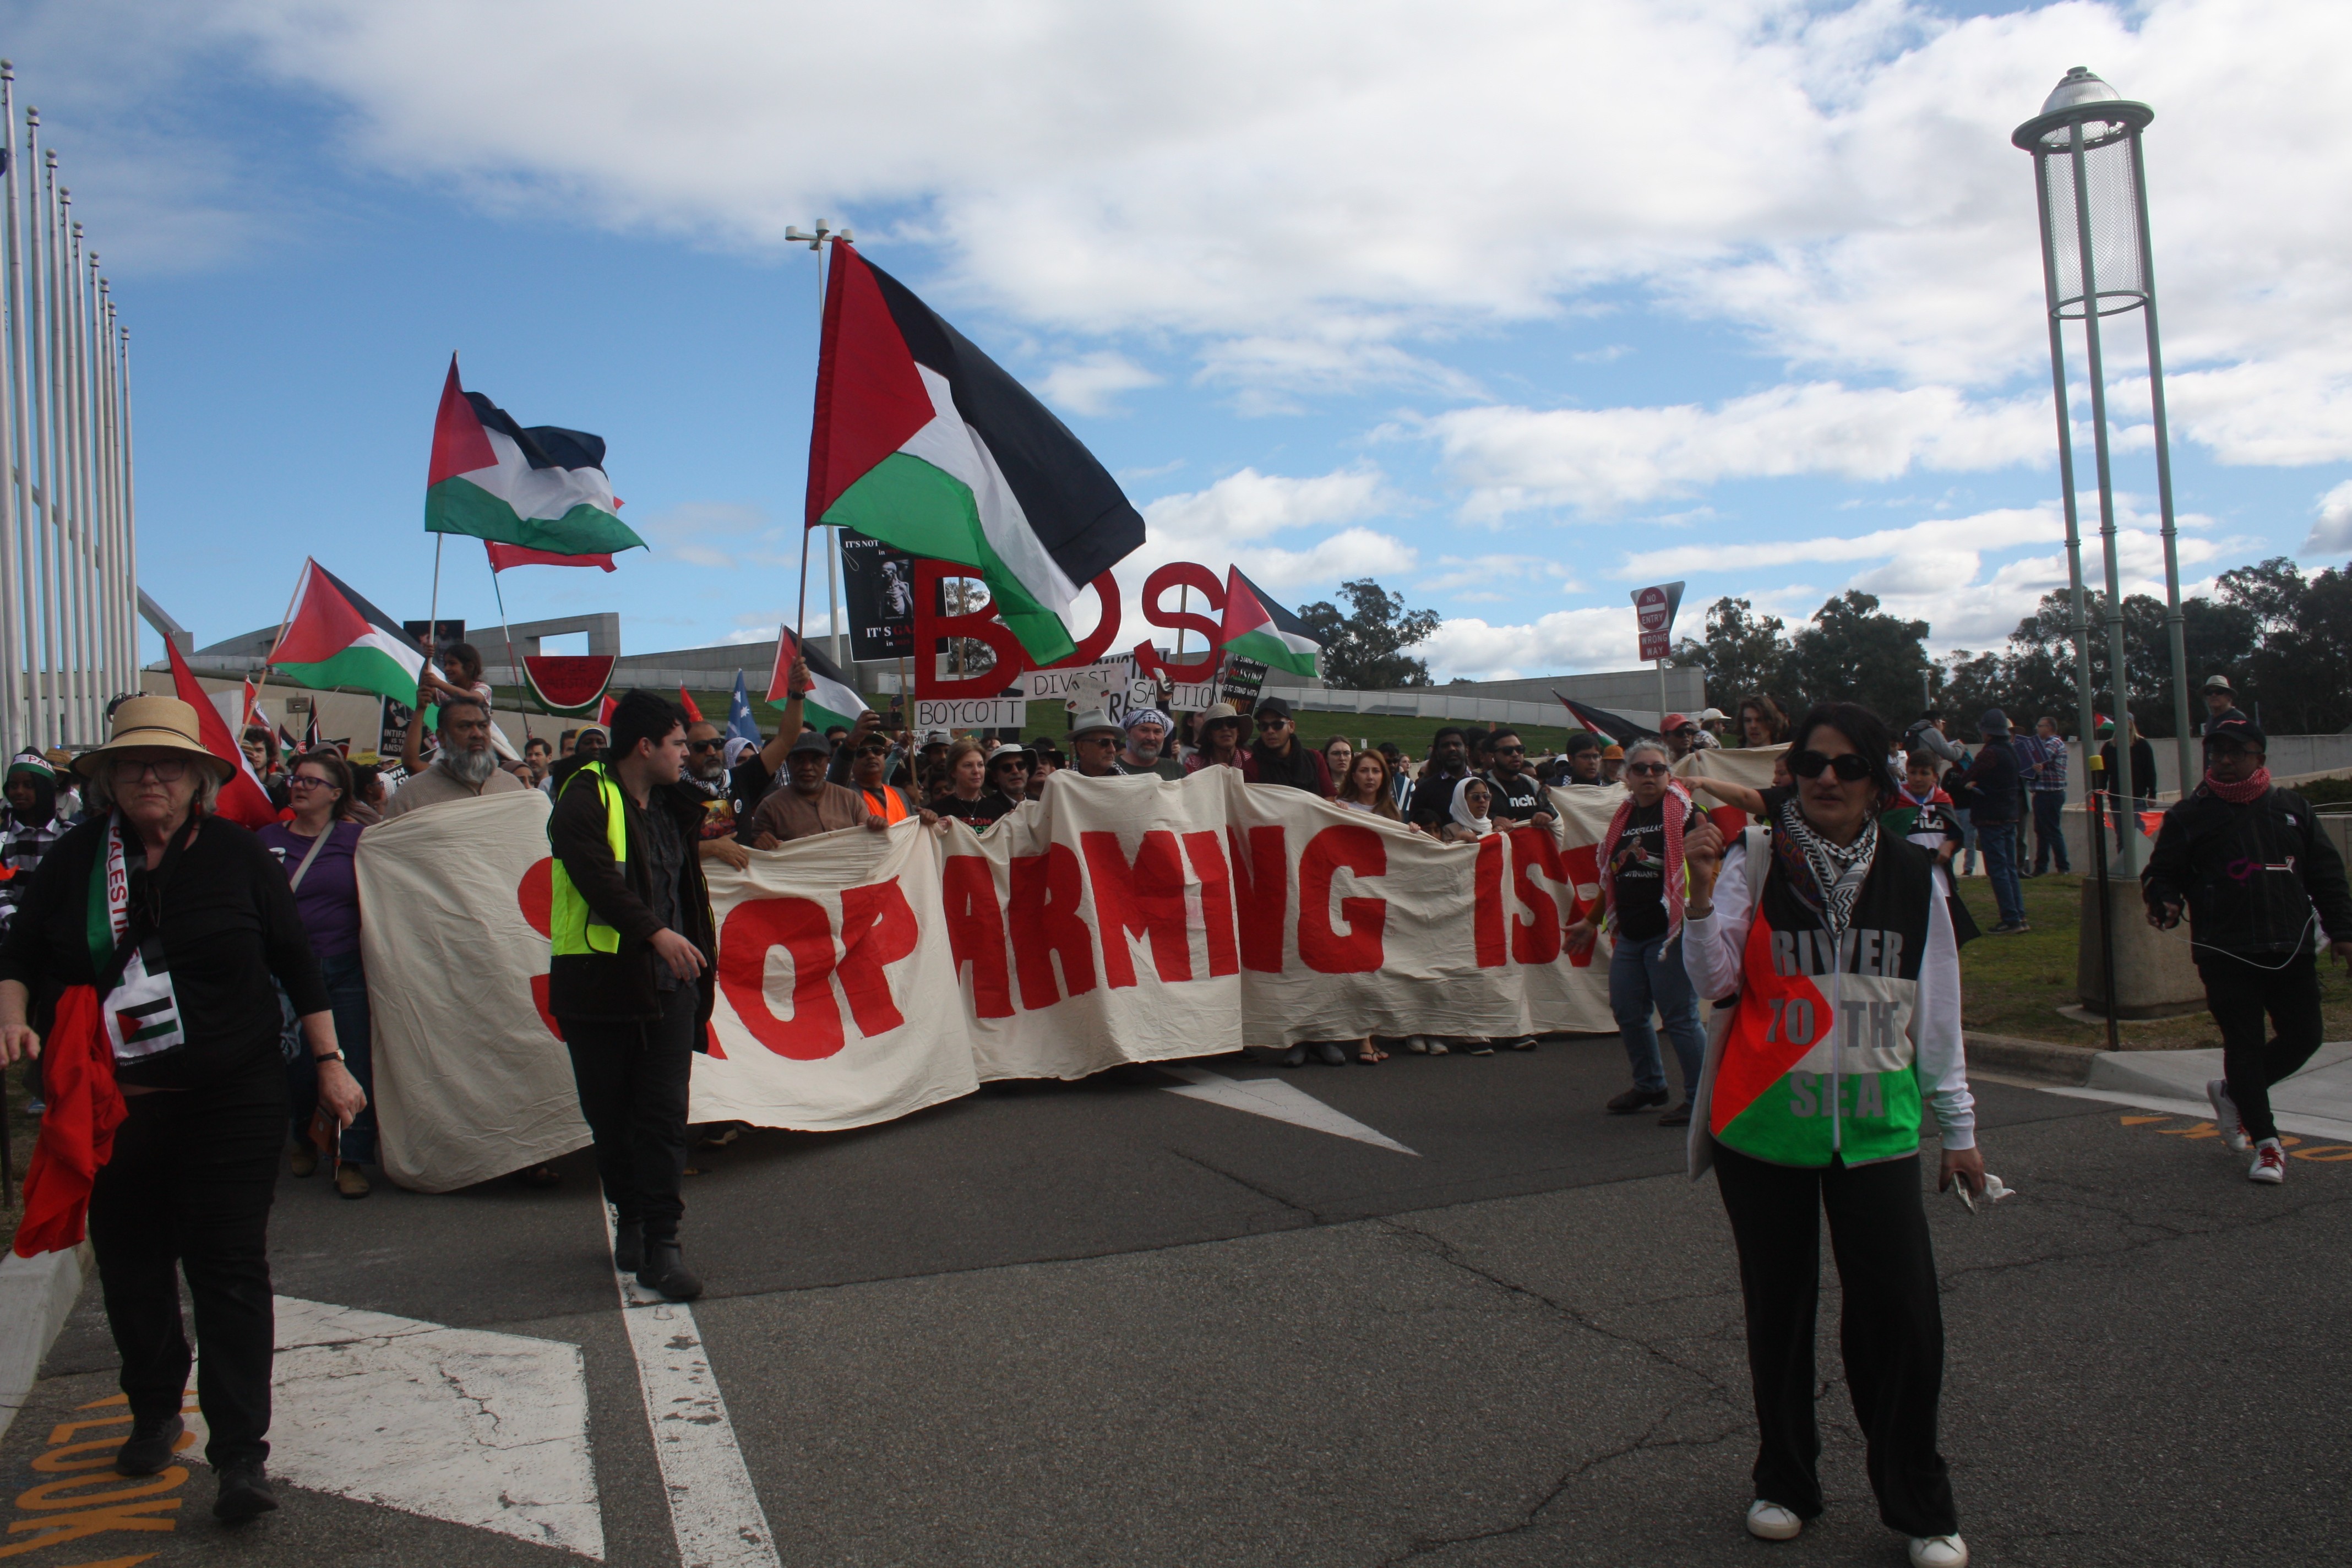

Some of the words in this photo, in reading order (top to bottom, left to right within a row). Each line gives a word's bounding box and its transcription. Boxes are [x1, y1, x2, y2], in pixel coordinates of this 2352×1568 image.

[845, 540, 861, 548] IT'S
[862, 539, 879, 548] NOT
[1646, 594, 1656, 603] NO
[1641, 613, 1663, 624] ENTRY
[1641, 633, 1668, 645] WRONG
[1646, 646, 1663, 657] WAY
[1233, 686, 1246, 695] STAND
[920, 700, 1022, 725] BOYCOTT
[1621, 824, 1663, 836] LACKFULLAS
[944, 825, 1386, 1019] ARMING
[1770, 929, 1903, 978] RIVER
[1789, 1072, 1886, 1118] SEA
